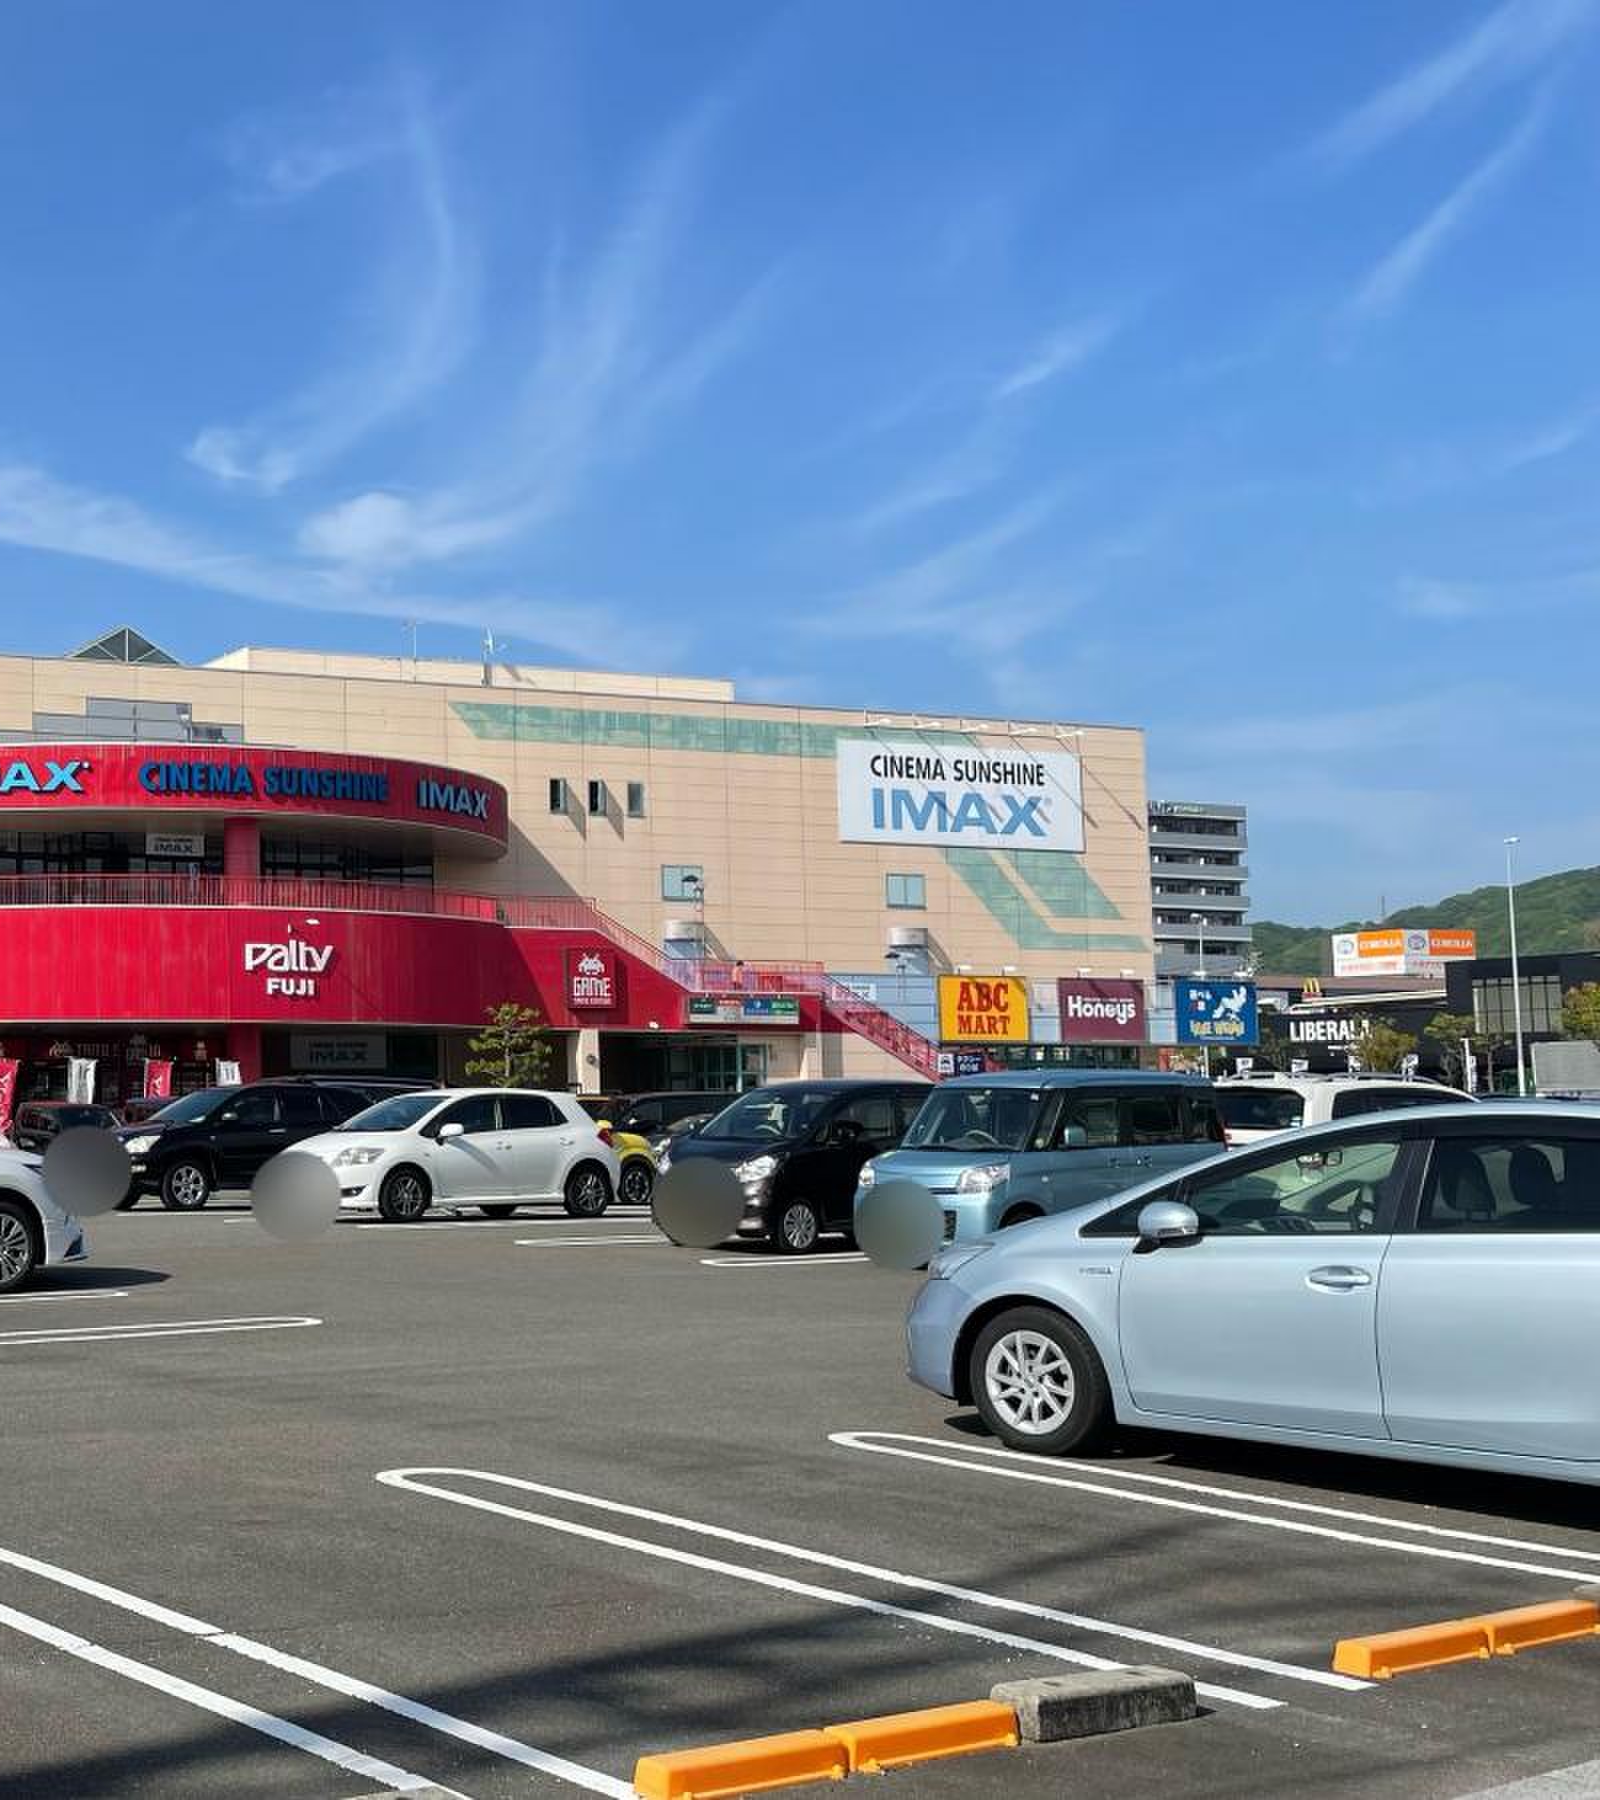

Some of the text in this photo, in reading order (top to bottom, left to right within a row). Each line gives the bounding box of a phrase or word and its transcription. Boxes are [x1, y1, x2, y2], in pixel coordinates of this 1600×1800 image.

[139, 761, 390, 802] CINEMA SUNSHINE
[870, 755, 1046, 786] CINEMA SUNSHINE
[418, 779, 489, 818] IMAX
[872, 787, 1047, 837] IMAX
[267, 978, 315, 996] FUJI
[574, 976, 611, 996] GAME
[958, 981, 1009, 1012] ABC
[958, 1014, 1011, 1036] MART
[1068, 995, 1136, 1025] Honeys
